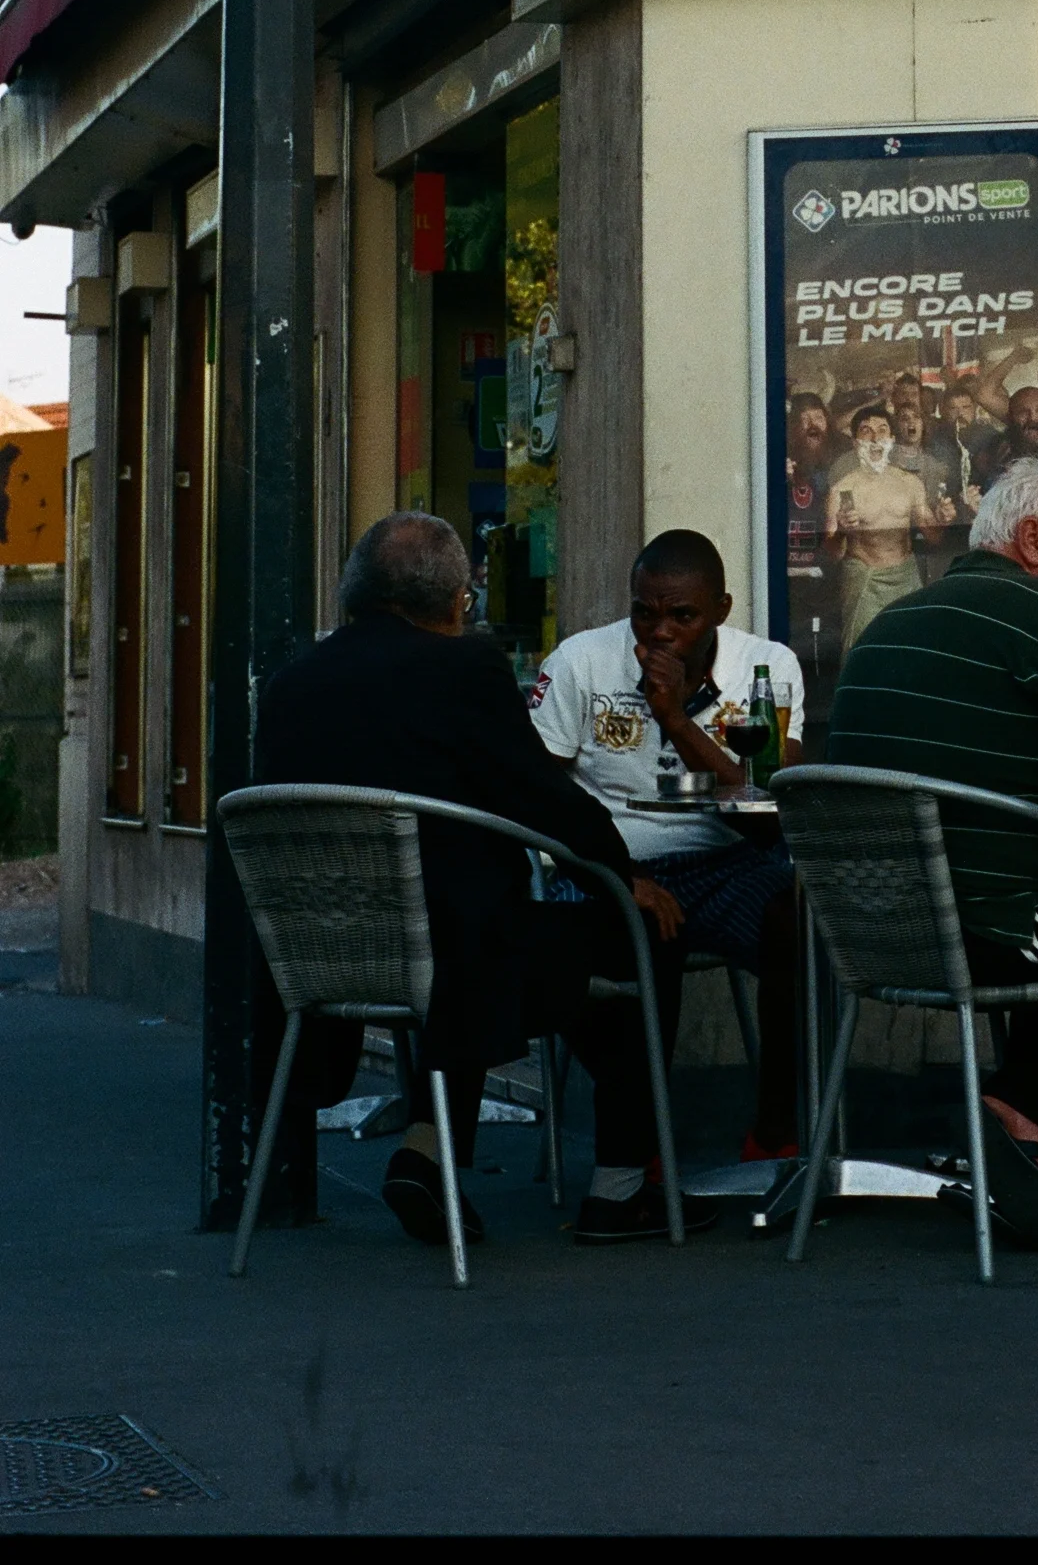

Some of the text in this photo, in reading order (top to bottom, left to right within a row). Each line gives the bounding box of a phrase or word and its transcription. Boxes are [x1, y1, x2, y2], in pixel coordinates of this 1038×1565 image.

[841, 183, 1027, 219] PARIONS sport
[924, 209, 1031, 224] POINT DE VENTE
[796, 272, 965, 301] ENCORE
[796, 290, 1034, 324] PLUS DANS
[798, 316, 1007, 347] LE MATCH
